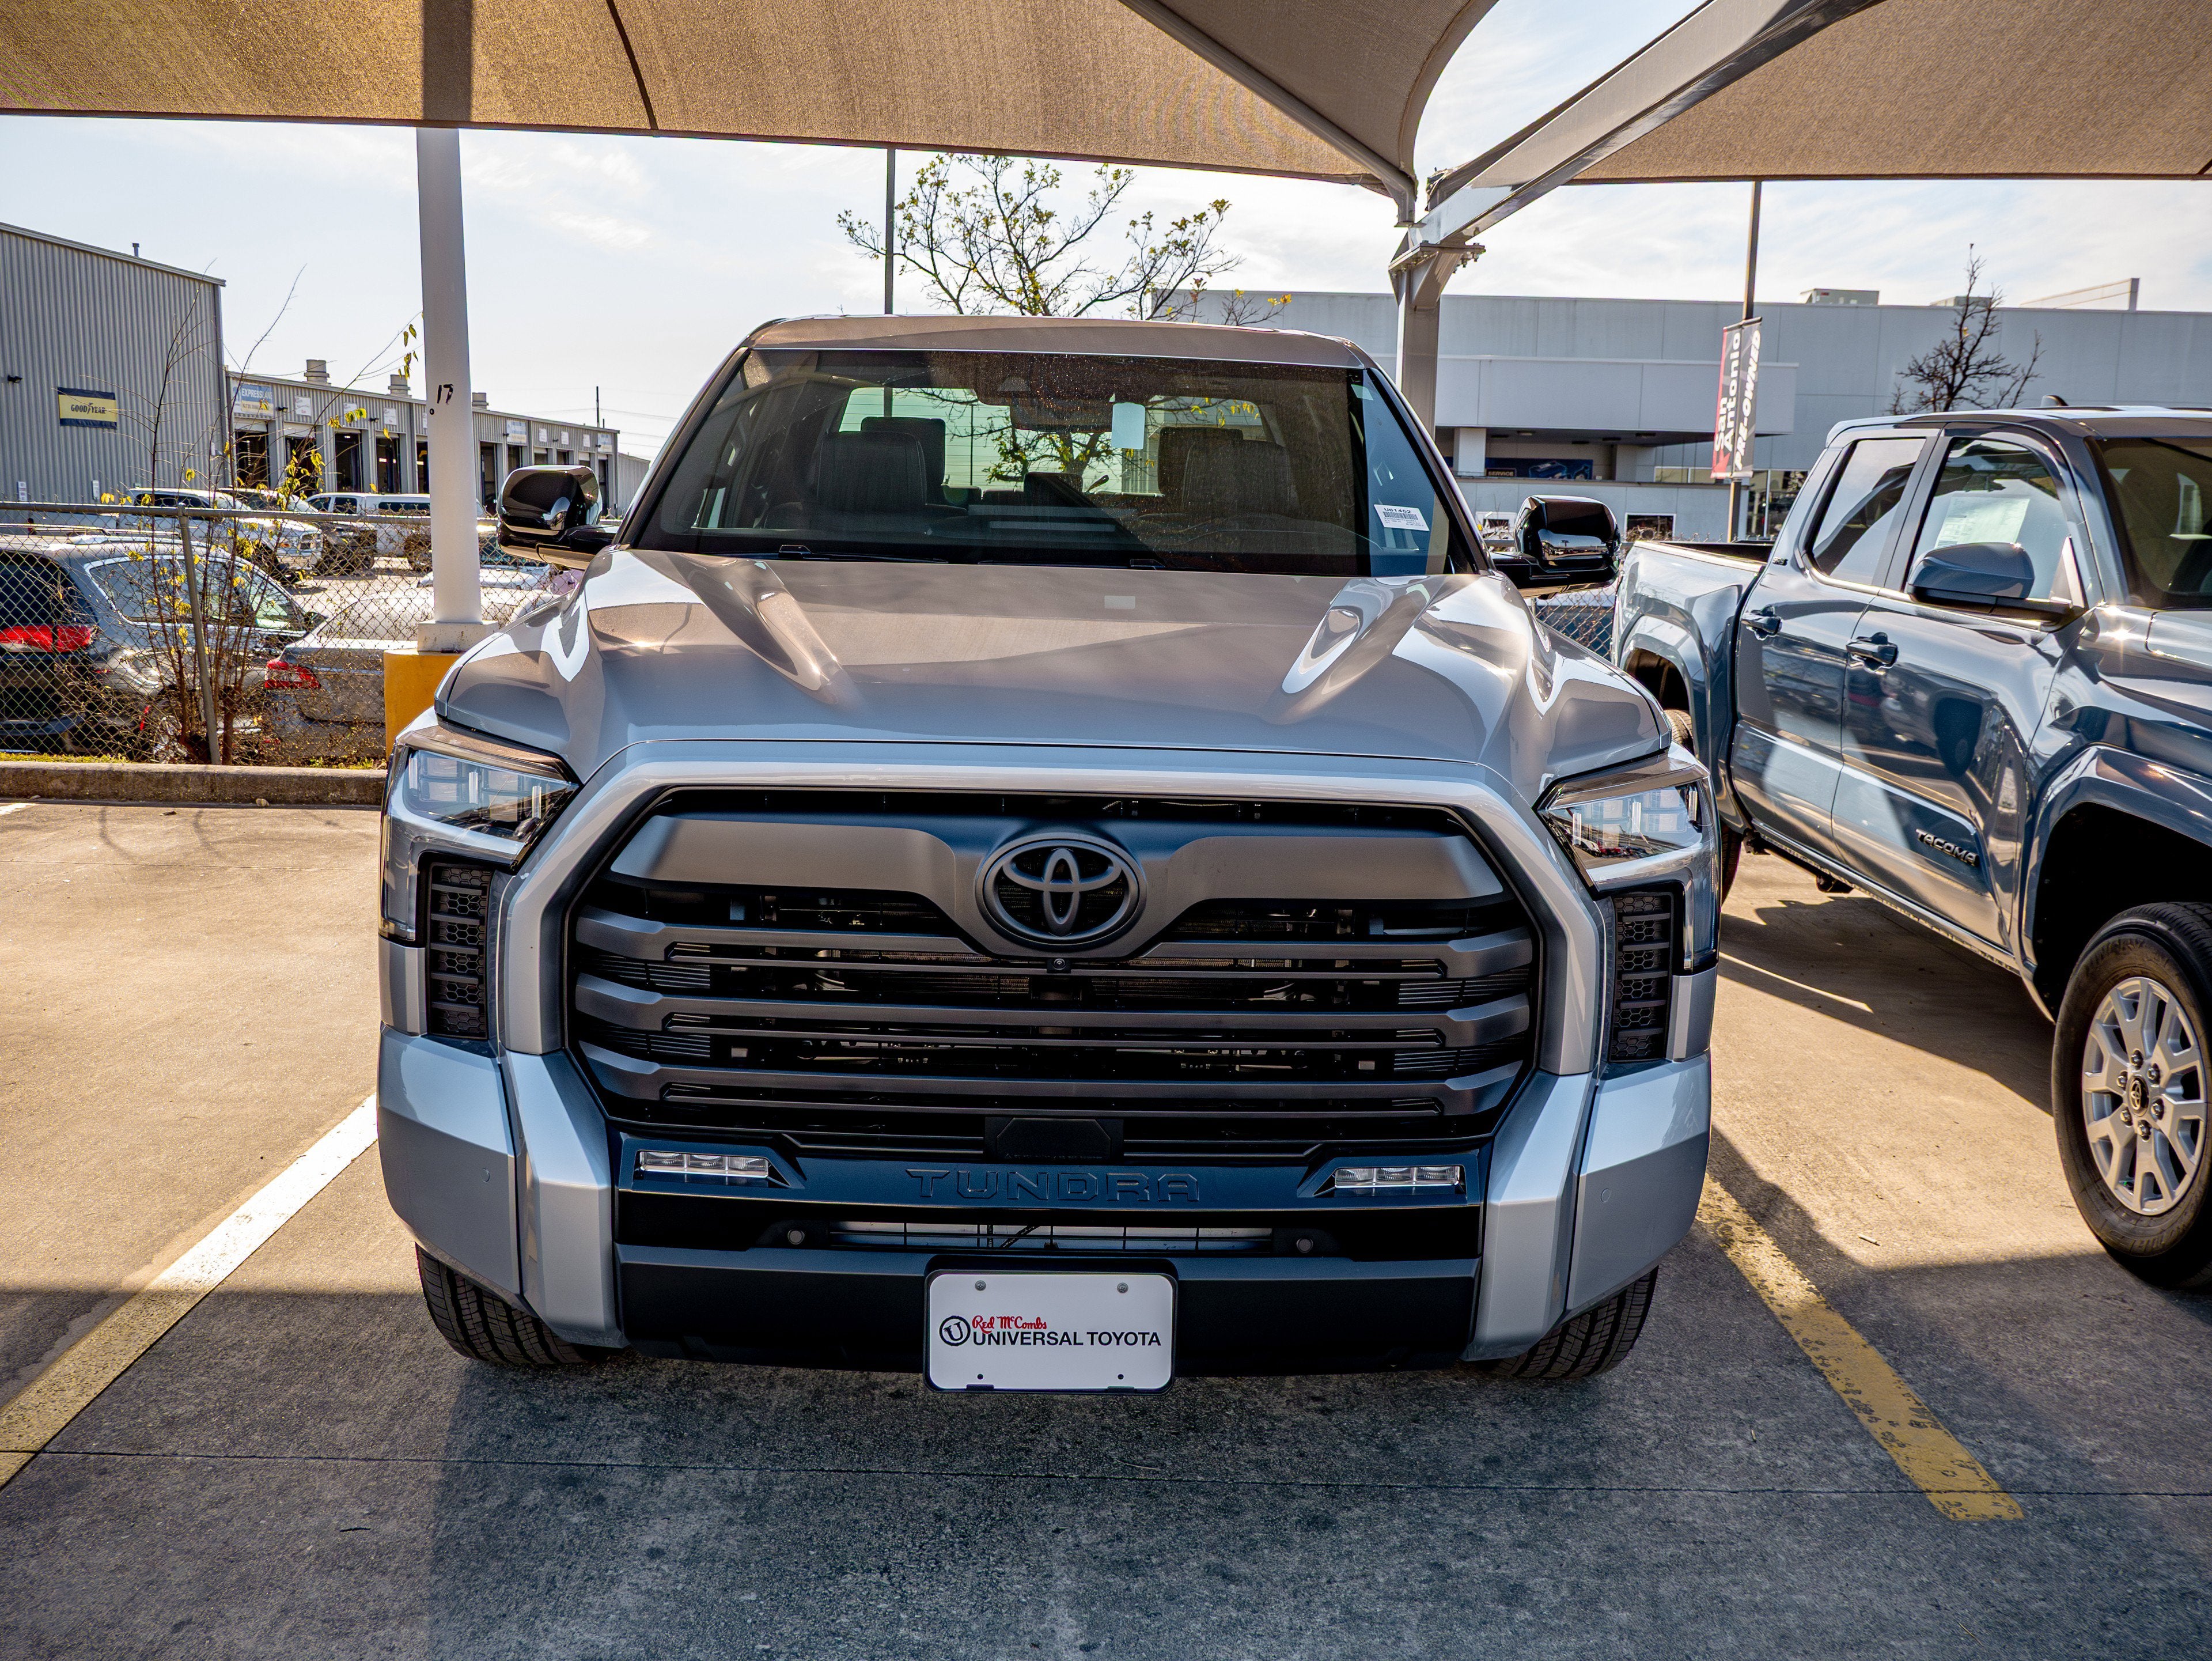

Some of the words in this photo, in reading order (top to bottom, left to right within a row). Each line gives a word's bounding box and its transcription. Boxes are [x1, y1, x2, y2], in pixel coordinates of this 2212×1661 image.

[437, 384, 454, 404] 17
[1724, 332, 1741, 452] Antonio
[1734, 330, 1761, 471] PRE-OWNED
[1715, 397, 1728, 452] San
[1915, 828, 1980, 867] TACOMA
[906, 1168, 1200, 1201] TUNDRA
[972, 1315, 995, 1334] Red
[997, 1315, 1047, 1330] McCombs
[973, 1331, 1084, 1346] UNIVERSAL
[1086, 1331, 1162, 1346] TOYOTA
